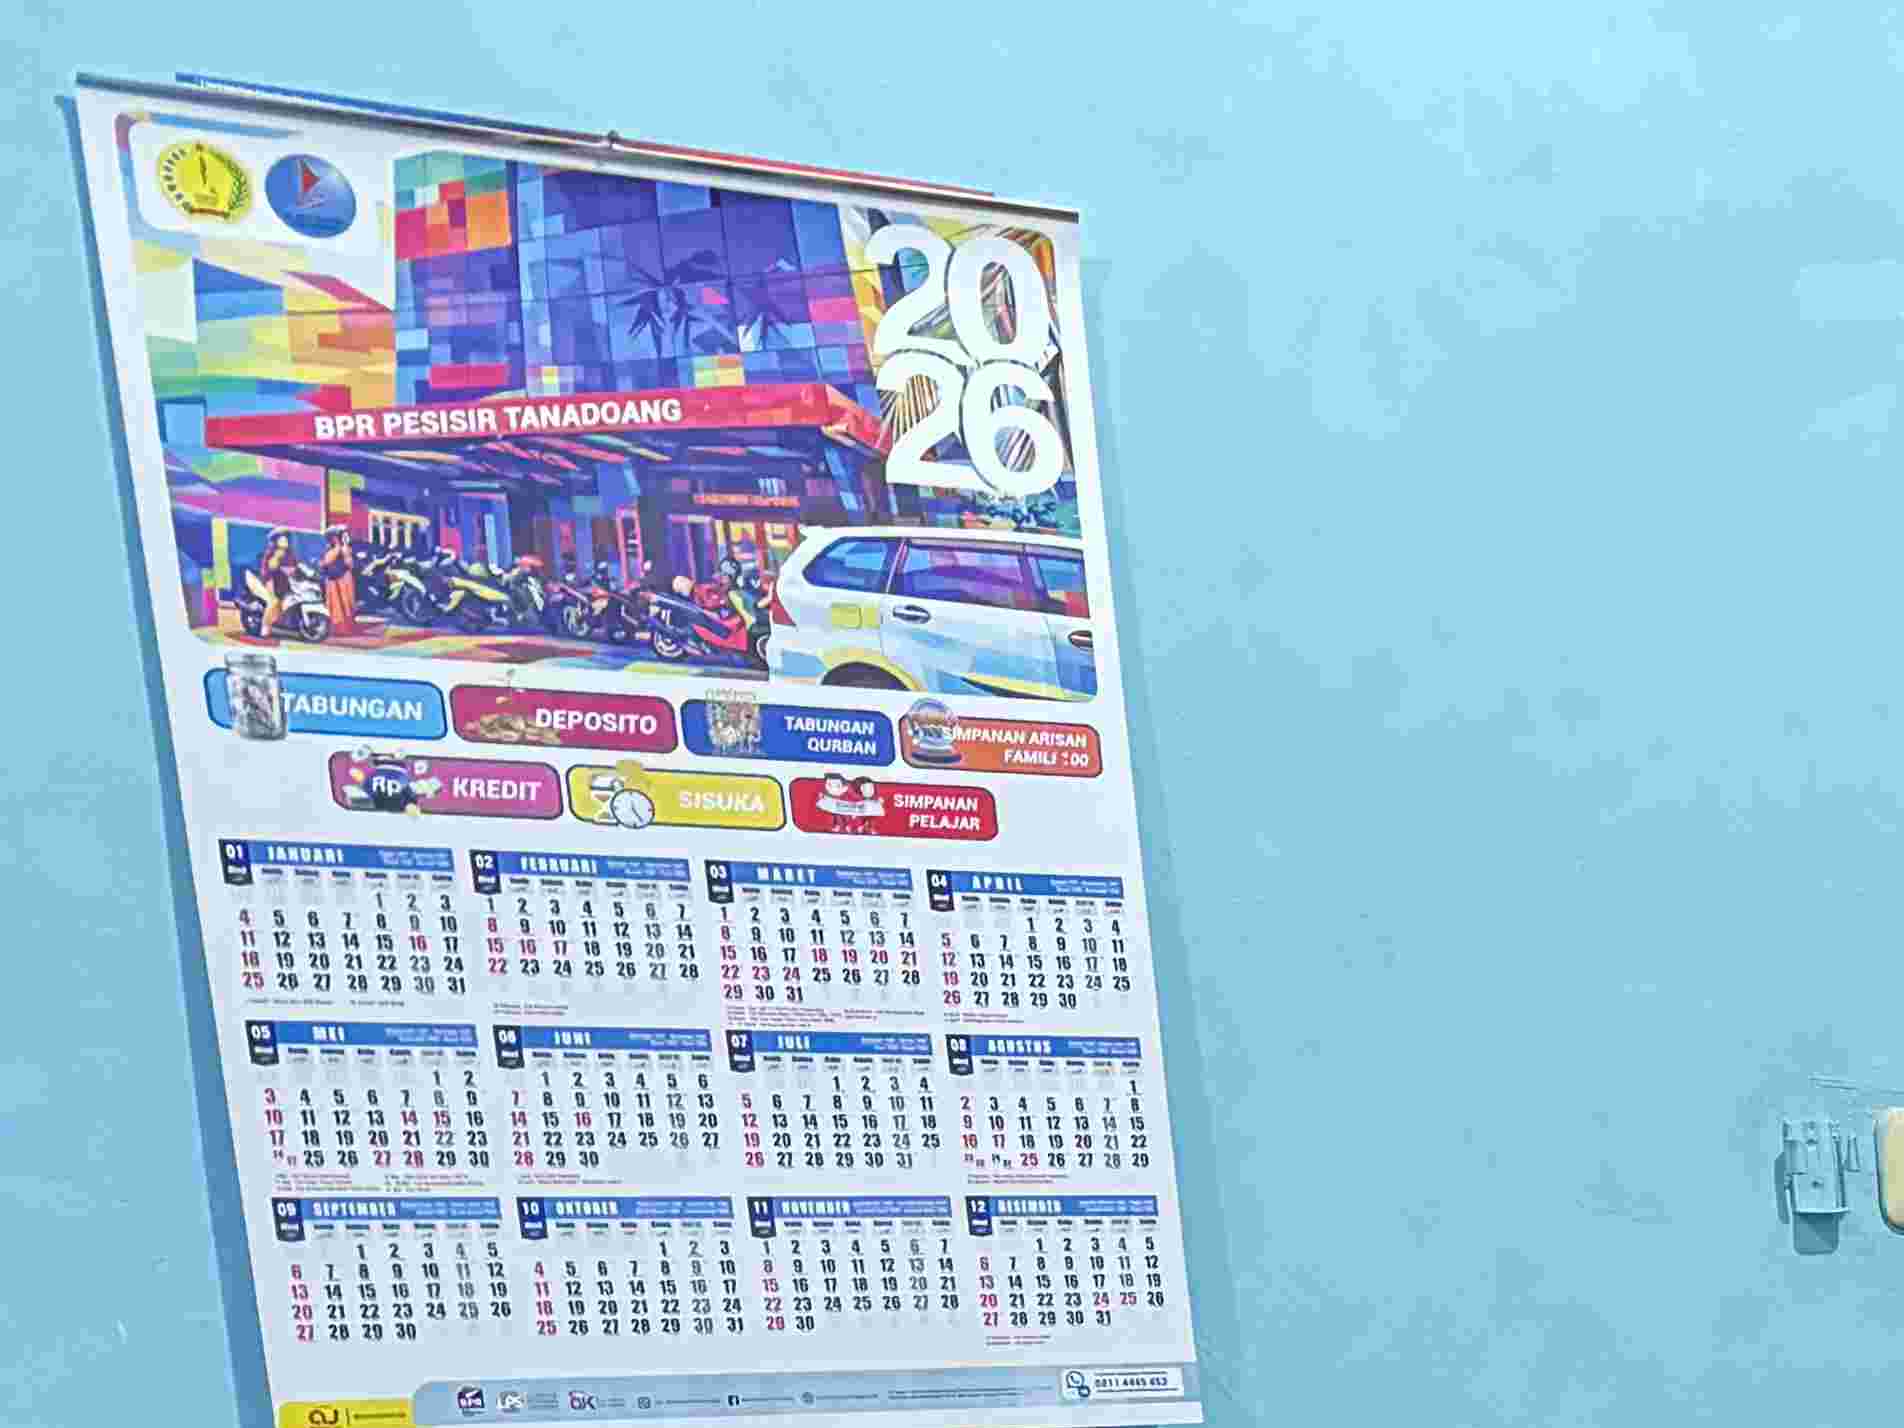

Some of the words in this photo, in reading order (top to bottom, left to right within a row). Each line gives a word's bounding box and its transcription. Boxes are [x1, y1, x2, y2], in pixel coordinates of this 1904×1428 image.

[864, 224, 1046, 364] 20
[314, 416, 376, 438] BPR
[383, 408, 497, 437] PESISIR
[504, 399, 681, 428] TANADOANG
[885, 352, 1064, 493] 26
[281, 693, 422, 721] TABUNGAN
[535, 708, 657, 733] DEPOSITO
[784, 716, 875, 734] TABUNGAN
[808, 737, 876, 755] QURBAN
[944, 727, 1025, 743] SIMPANAN
[1029, 732, 1087, 747] ARISAN
[1004, 750, 1057, 765] FAMILI
[372, 776, 400, 796] Rp
[452, 777, 542, 801] KREDIT
[679, 791, 764, 812] SISUKA
[894, 794, 978, 811] SIMPANAN
[909, 815, 980, 830] PELAJAR
[273, 931, 291, 948] 12
[308, 932, 326, 949] 13
[342, 933, 360, 950] 14
[376, 934, 394, 951] 15
[443, 936, 458, 953] 17
[520, 959, 540, 976] 23
[553, 960, 572, 976] 24
[584, 961, 605, 977] 25
[649, 962, 666, 979] 27
[970, 953, 985, 968] 13
[999, 954, 1014, 969] 14
[1027, 954, 1043, 970] 15
[1085, 956, 1098, 971] 17
[751, 965, 771, 981] 23
[782, 966, 800, 981] 24
[812, 967, 831, 982] 25
[873, 969, 889, 984] 27
[300, 1110, 316, 1126] 11
[334, 1110, 351, 1127] 12
[367, 1110, 385, 1127] 13
[401, 1110, 417, 1127] 14
[433, 1110, 450, 1127] 15
[1019, 1115, 1032, 1130] 11
[1046, 1115, 1061, 1130] 12
[1074, 1116, 1089, 1130] 13
[1101, 1116, 1117, 1130] 14
[1129, 1116, 1145, 1130] 15
[544, 1132, 562, 1147] 22
[575, 1132, 596, 1147] 23
[608, 1132, 627, 1147] 24
[639, 1132, 658, 1147] 25
[703, 1133, 720, 1148] 27
[804, 1133, 821, 1149] 21
[832, 1133, 851, 1149] 22
[863, 1133, 881, 1149] 23
[892, 1133, 910, 1149] 24
[921, 1133, 941, 1149] 25
[1008, 1274, 1023, 1289] 14
[1036, 1274, 1051, 1289] 15
[1093, 1274, 1106, 1289] 17
[325, 1283, 342, 1300] 14
[359, 1283, 376, 1299] 15
[426, 1283, 440, 1299] 17
[793, 1298, 812, 1312] 23
[824, 1297, 842, 1312] 24
[853, 1297, 872, 1311] 25
[913, 1295, 929, 1310] 27
[602, 1319, 620, 1335] 27
[728, 1317, 744, 1333] 31
